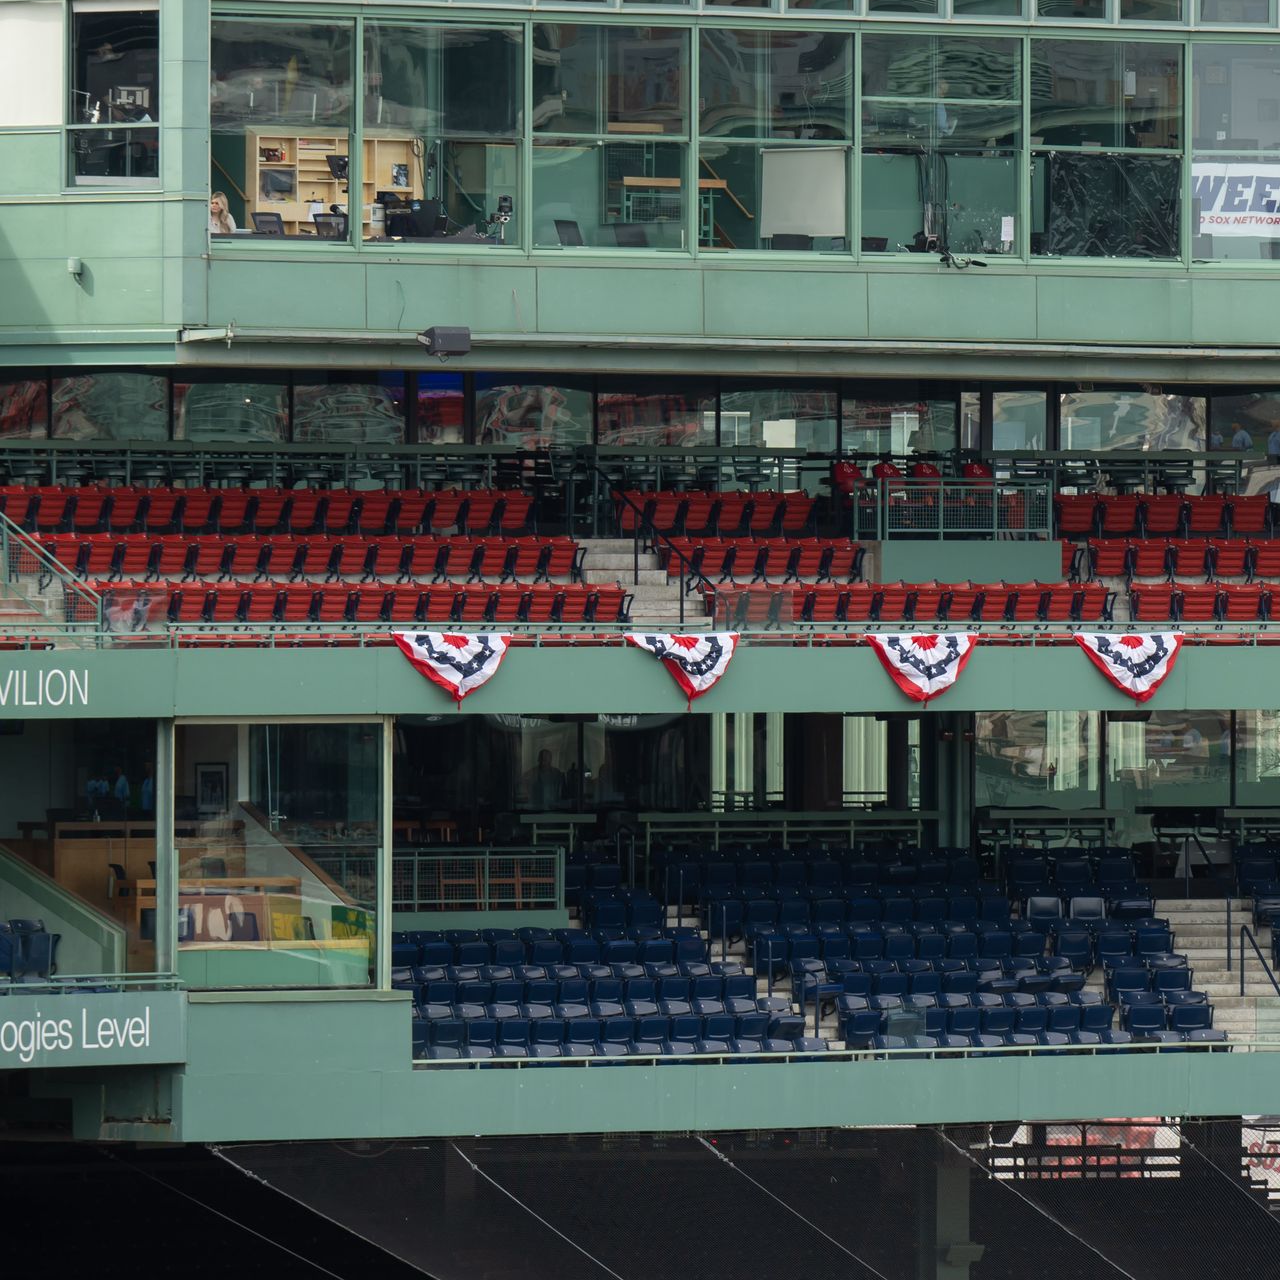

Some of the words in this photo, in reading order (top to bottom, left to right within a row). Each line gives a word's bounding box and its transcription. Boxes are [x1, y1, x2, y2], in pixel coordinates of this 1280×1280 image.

[1208, 216, 1229, 224] SOX
[0, 1012, 73, 1063] ogies
[82, 1006, 150, 1048] Level
